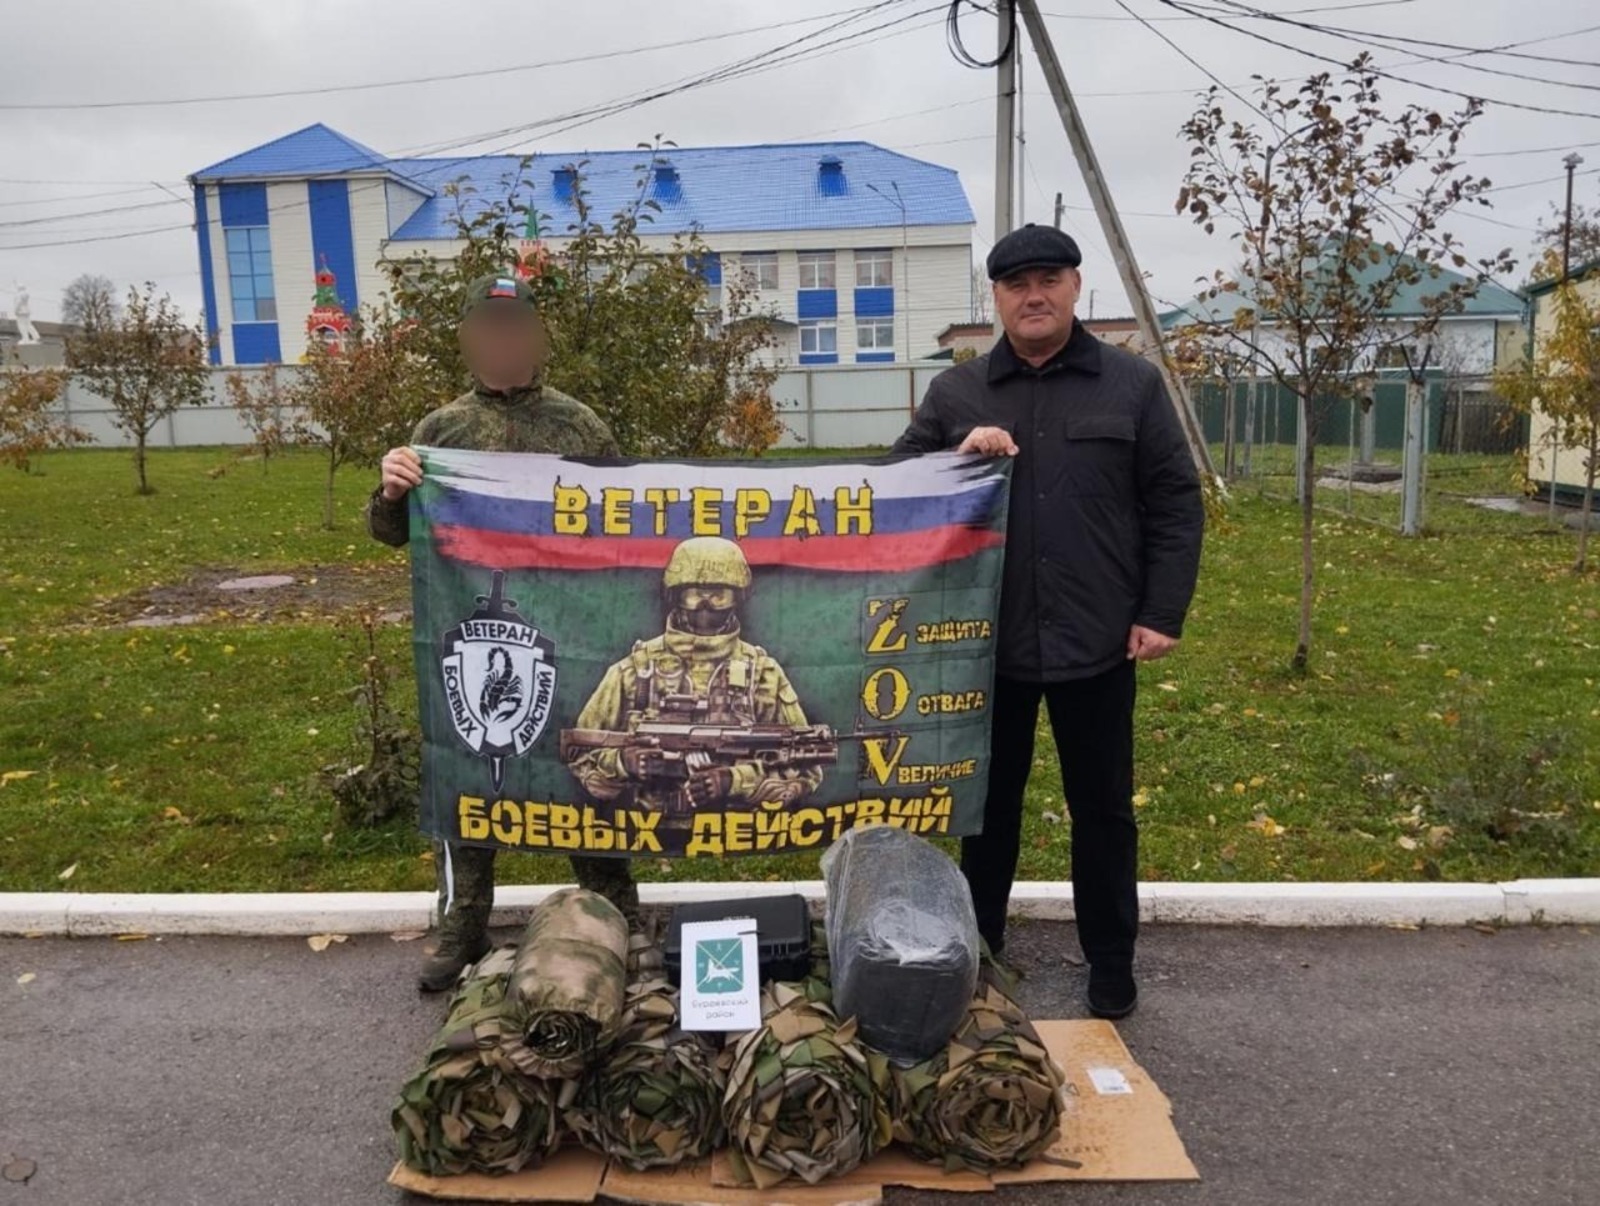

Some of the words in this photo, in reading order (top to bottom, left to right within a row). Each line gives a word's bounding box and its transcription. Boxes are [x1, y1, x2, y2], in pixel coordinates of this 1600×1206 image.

[553, 480, 874, 539] ВЕТЕРАН
[465, 621, 534, 643] ВЕТЕРАН
[867, 599, 910, 652] Z
[916, 620, 992, 643] ЗАЩИТА
[444, 666, 478, 739] БОЕВЫХ
[518, 670, 553, 748] ДЕЙСТВИЙ
[917, 691, 984, 715] ОТВАГА
[862, 735, 911, 786] V
[898, 759, 977, 784] ВЕЛИЧИЕ
[458, 794, 664, 852] БОЕВЫХ
[686, 785, 953, 858] ДЕЙСТВИЙ
